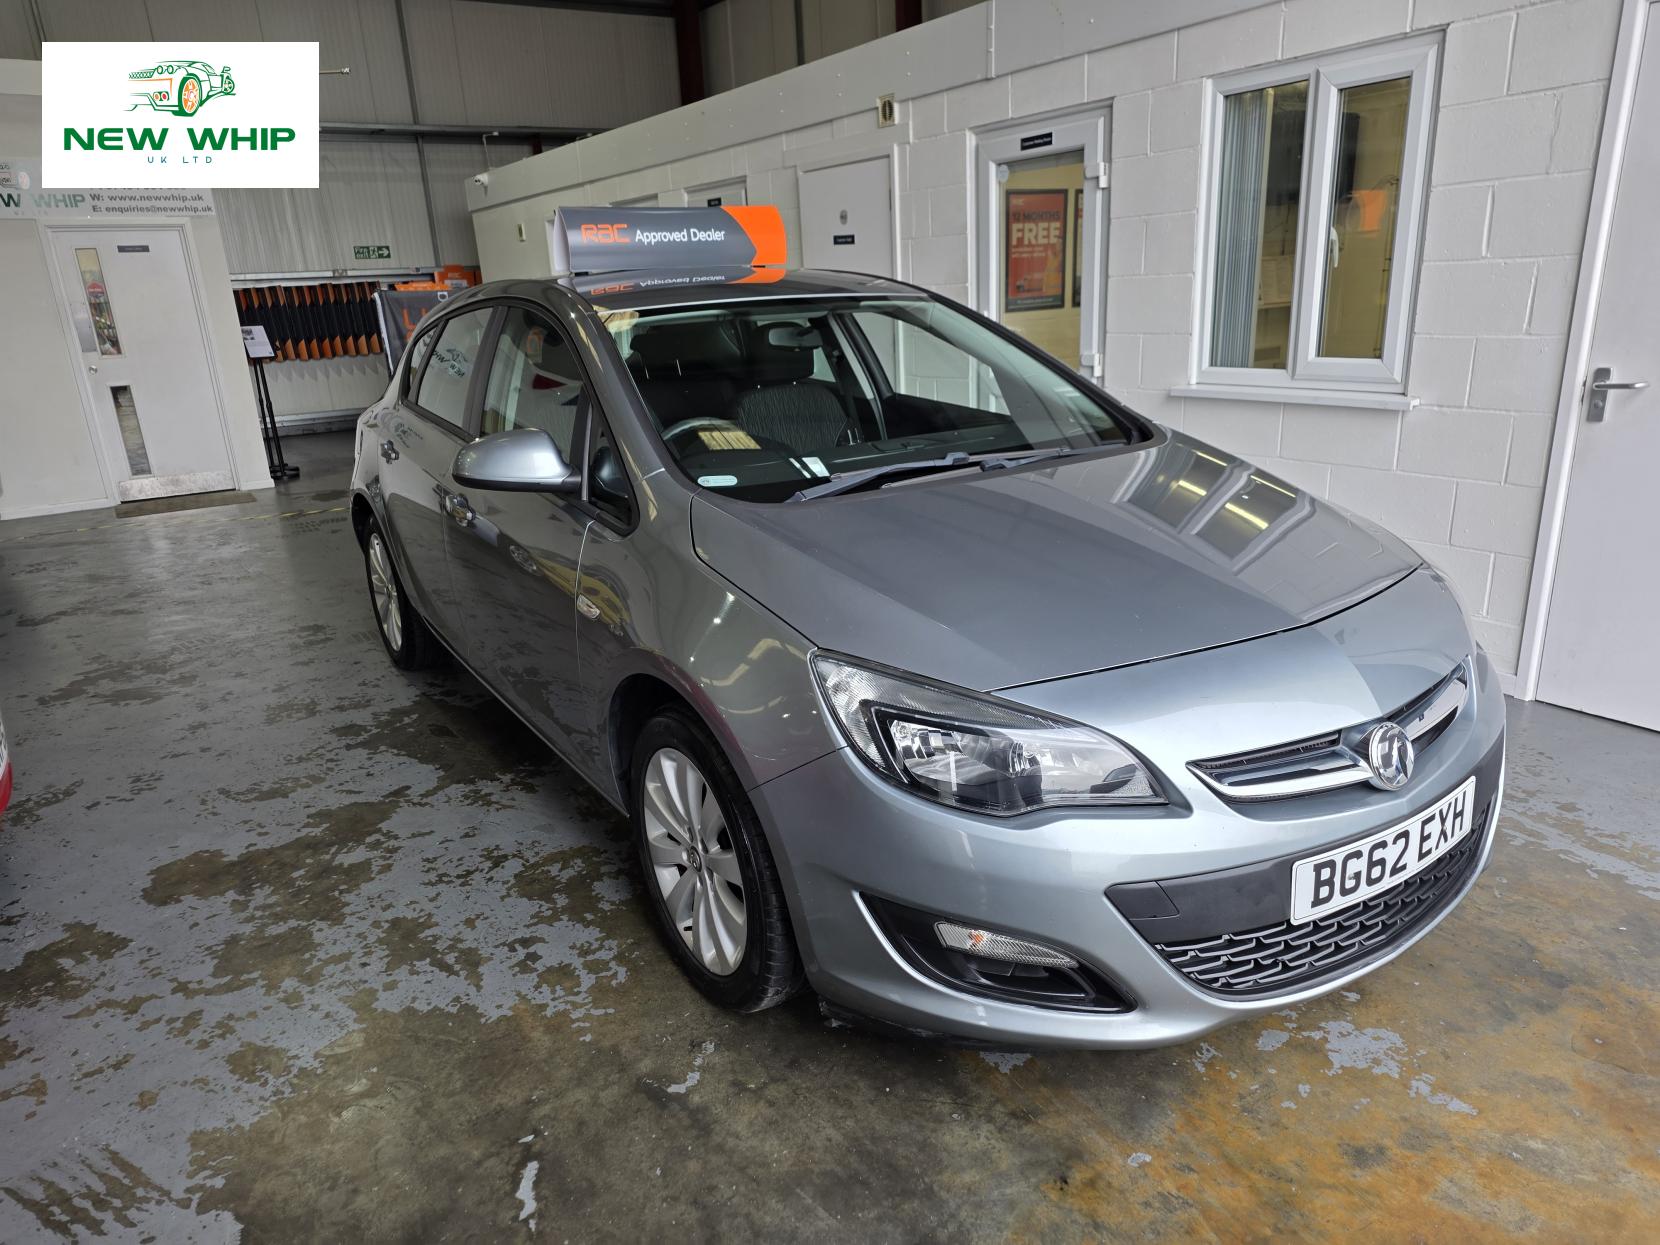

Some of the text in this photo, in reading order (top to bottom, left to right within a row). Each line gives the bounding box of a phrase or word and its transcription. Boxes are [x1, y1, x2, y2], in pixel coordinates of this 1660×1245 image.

[107, 194, 204, 203] www.newwhip.uk
[635, 228, 688, 246] Approved
[690, 227, 726, 242] Dealer
[1011, 222, 1061, 246] FREE
[1311, 790, 1467, 909] BG62 EXH
